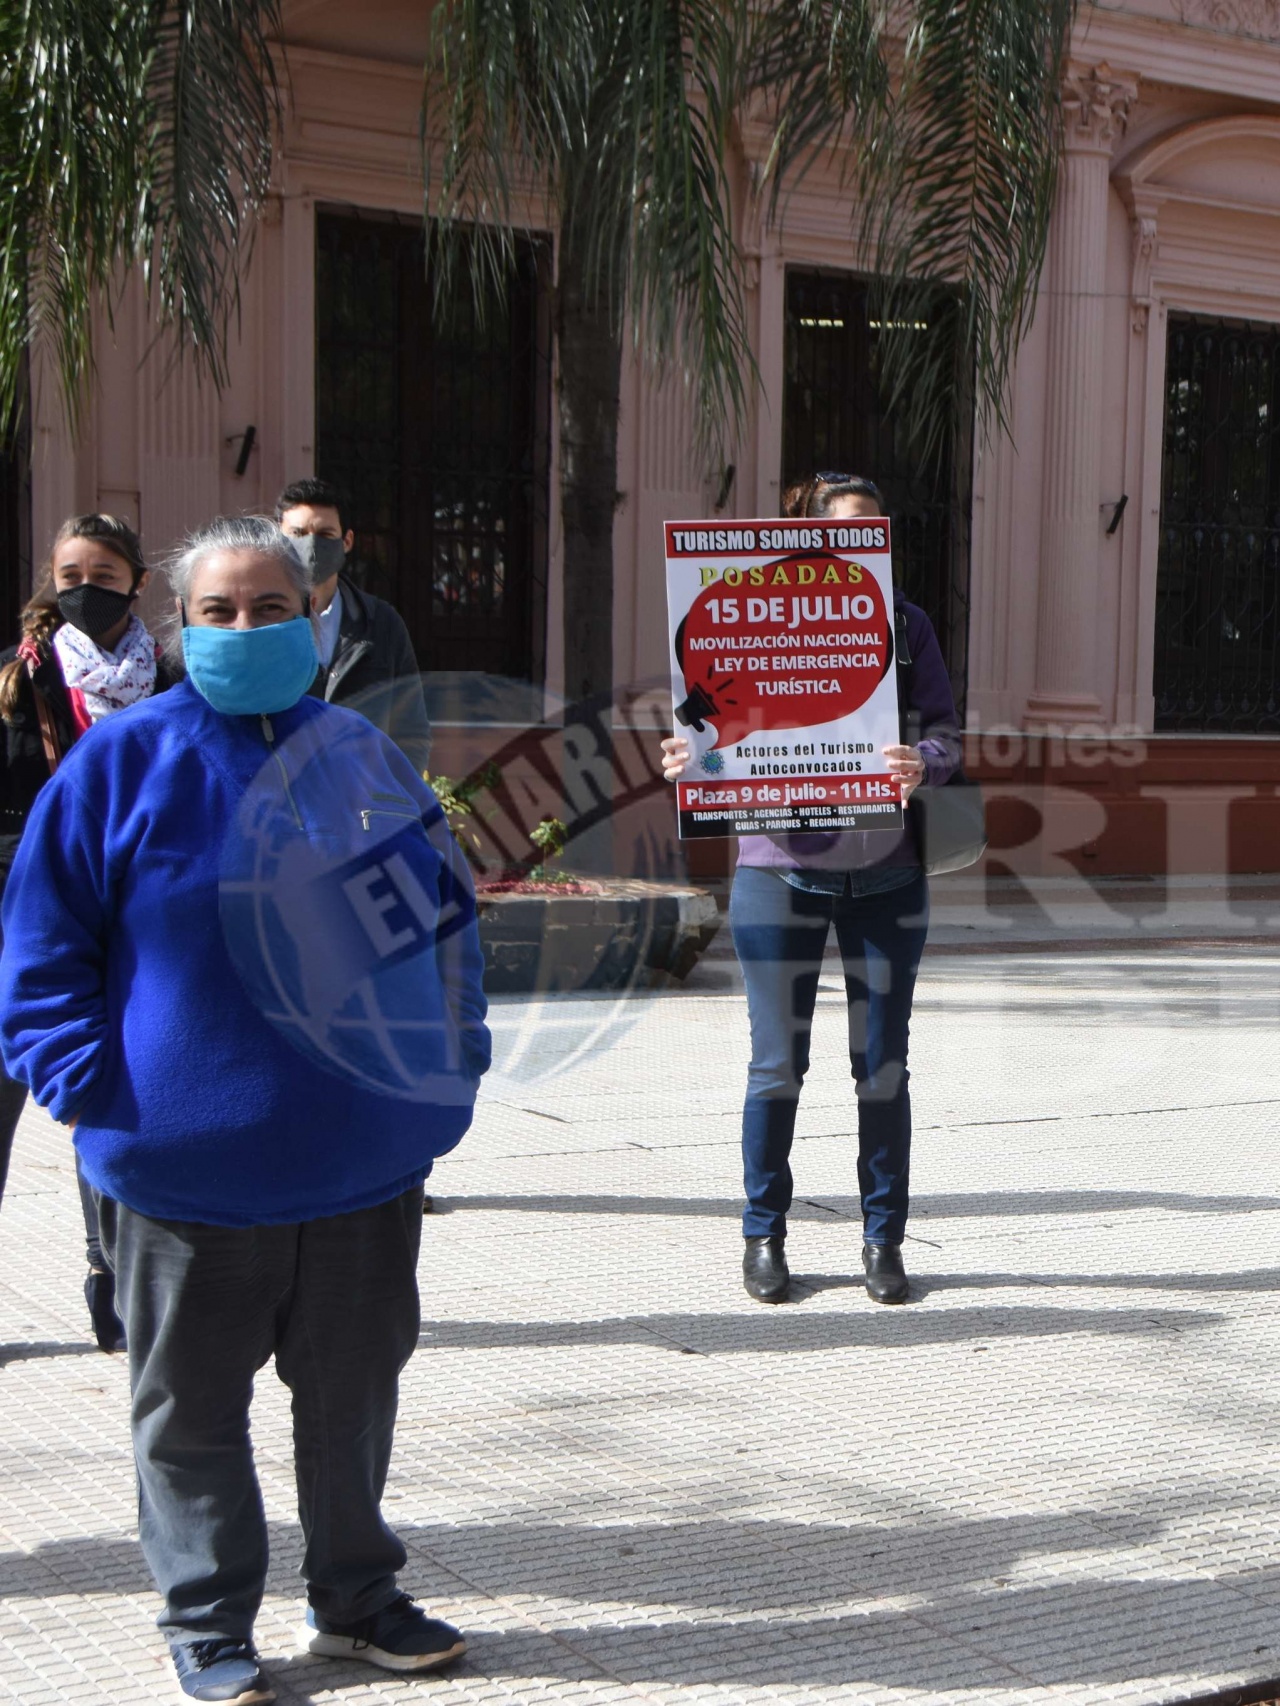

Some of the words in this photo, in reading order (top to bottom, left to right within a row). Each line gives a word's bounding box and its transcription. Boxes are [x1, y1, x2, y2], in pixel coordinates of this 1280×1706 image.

[672, 530, 756, 551] TURISMO
[759, 528, 823, 549] SOMOS
[826, 527, 885, 548] TODOS
[699, 563, 863, 587] POSADAS
[704, 598, 740, 624] 15
[747, 597, 785, 623] DE
[788, 595, 874, 629] JULIO
[689, 633, 800, 650] MOVILIZACIÓN
[803, 633, 882, 647] NACIONAL
[714, 657, 744, 672] LEY
[748, 657, 769, 671] DE
[772, 653, 880, 670] EMERGENCIA
[755, 677, 841, 696] TURÍSTICA
[736, 745, 789, 758] Actores
[794, 743, 814, 756] del
[820, 742, 873, 755] Turismo
[750, 761, 862, 775] Autoconvocados
[686, 788, 737, 805] Plaza
[740, 786, 752, 802] 9
[756, 784, 781, 801] de
[783, 783, 827, 805] julio
[840, 782, 861, 798] 11
[866, 781, 896, 797] Hs.
[692, 811, 748, 821] TRANSPORTES
[754, 808, 793, 818] AGENCIAS
[799, 807, 831, 816] HOTELES
[838, 804, 896, 815] RESTAURANTES
[766, 819, 801, 828] PARQUES
[809, 817, 856, 827] REGIONALES
